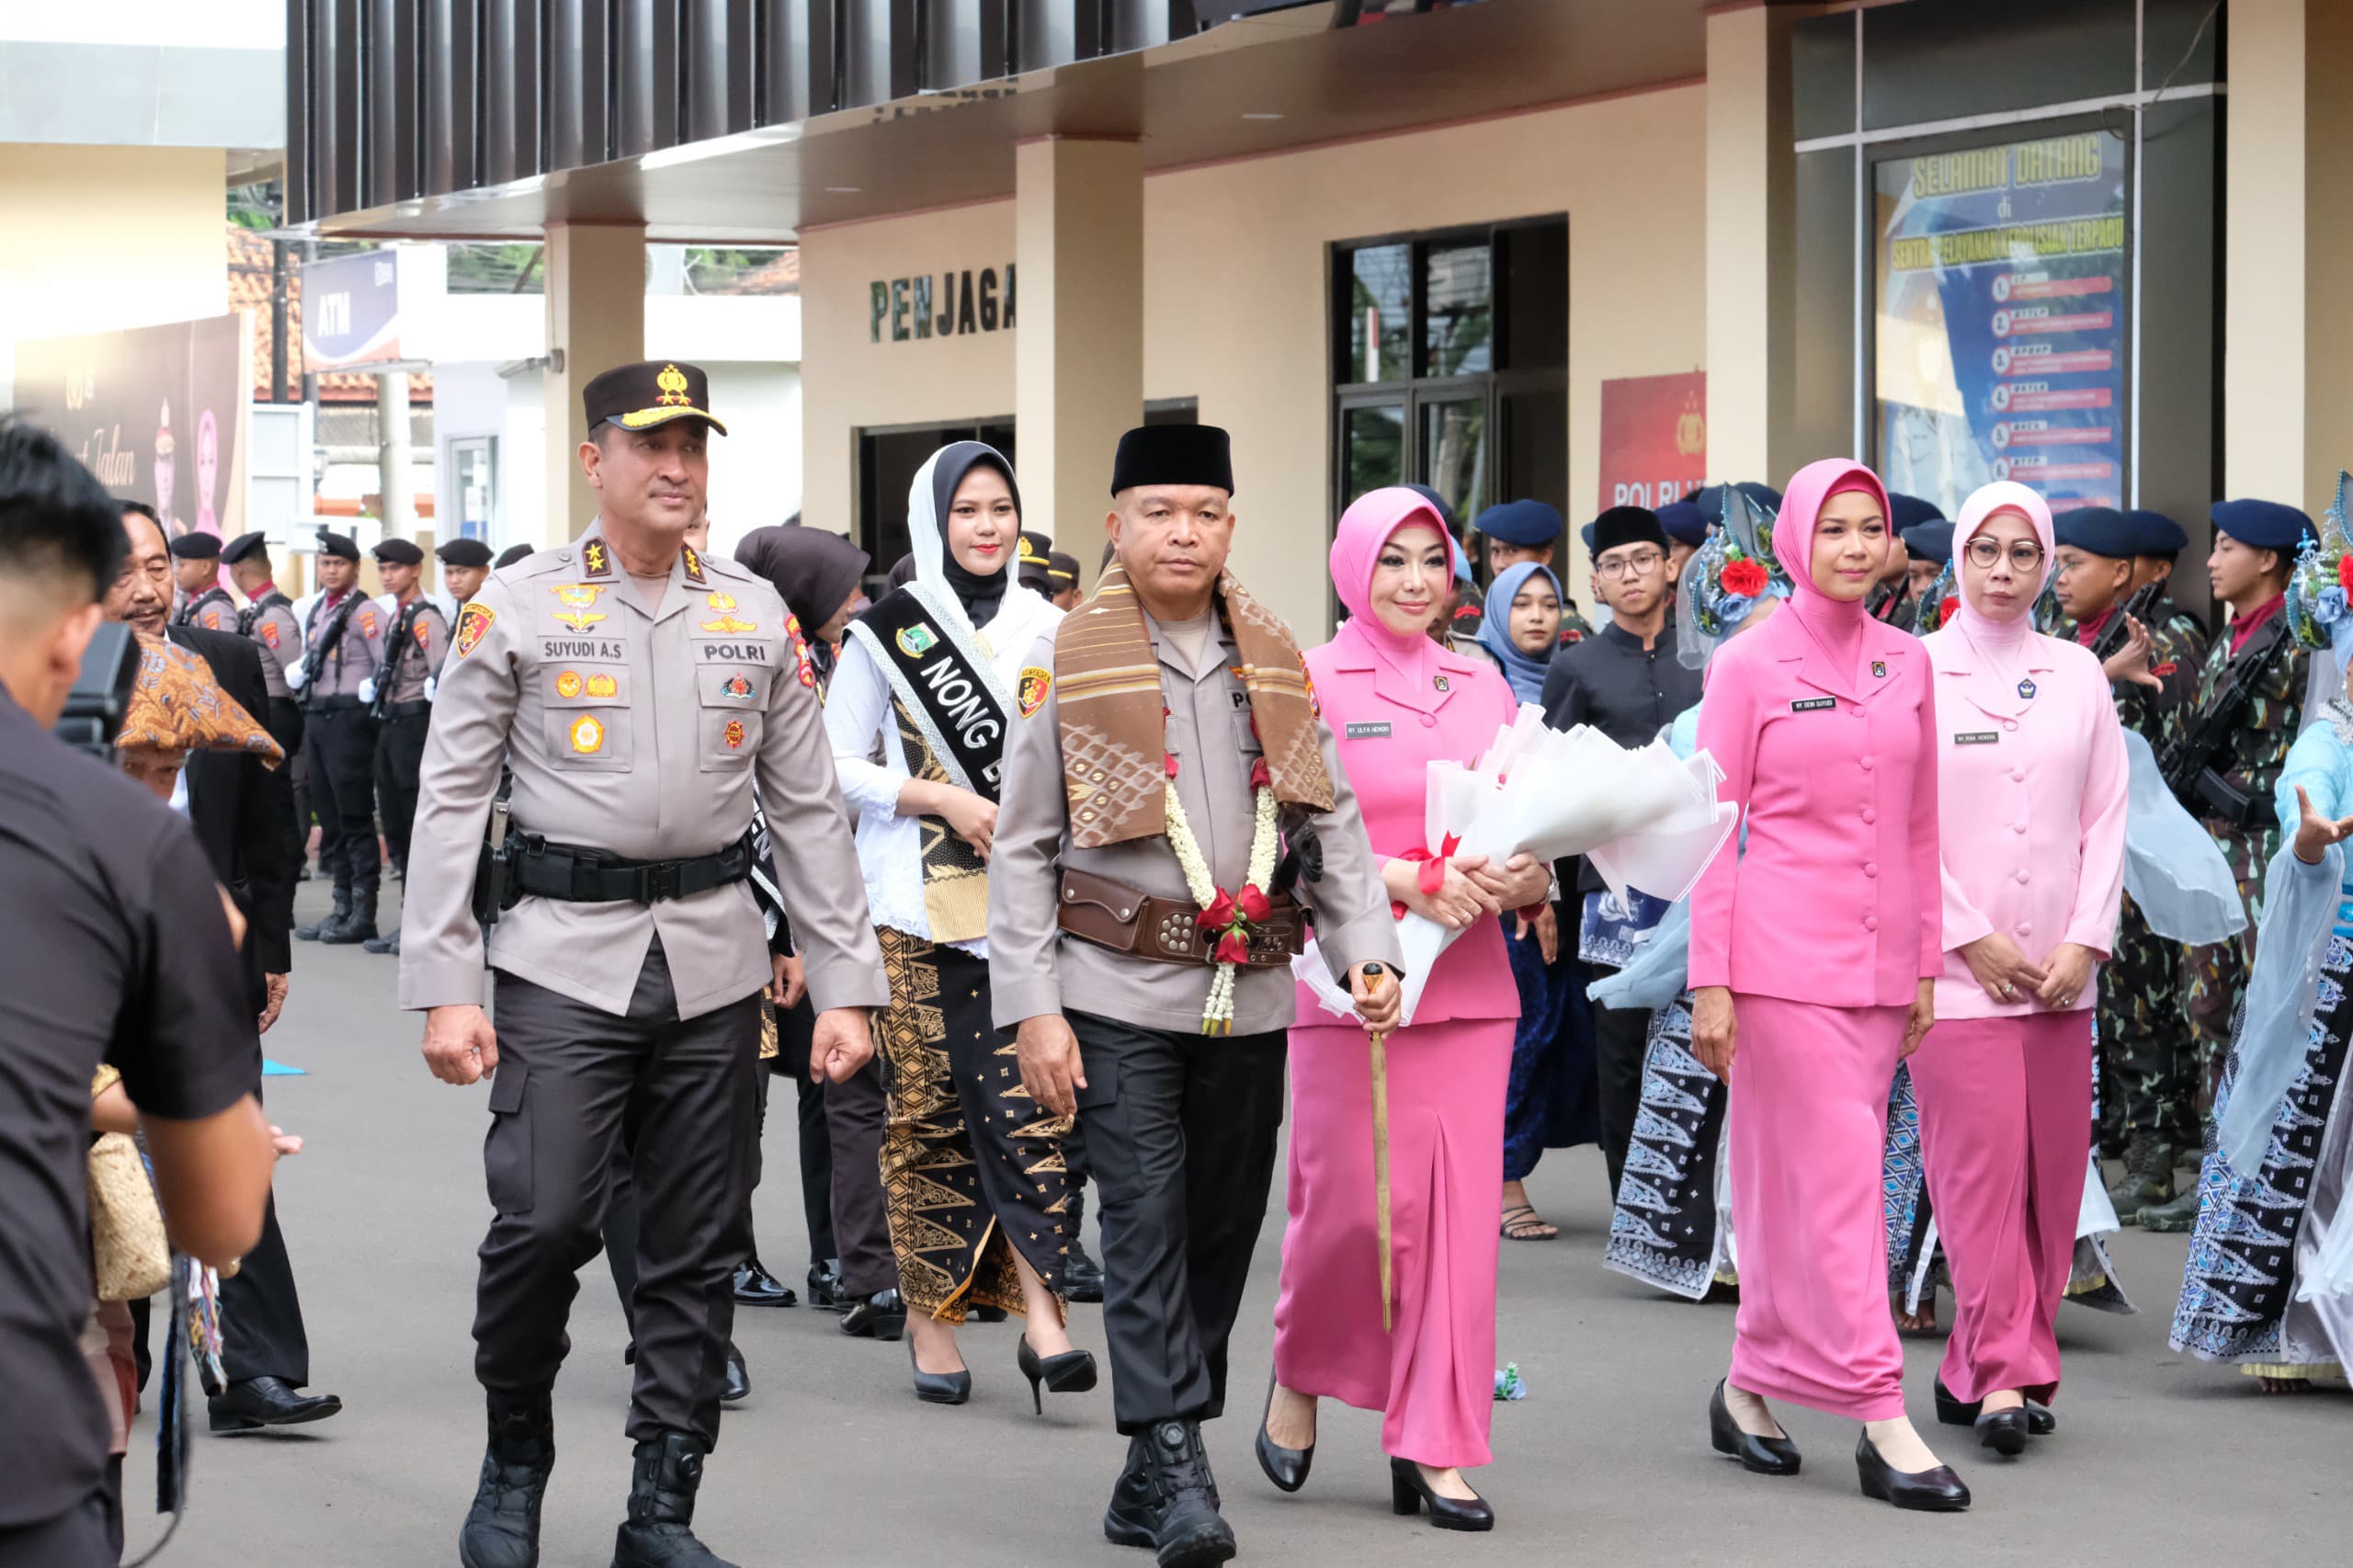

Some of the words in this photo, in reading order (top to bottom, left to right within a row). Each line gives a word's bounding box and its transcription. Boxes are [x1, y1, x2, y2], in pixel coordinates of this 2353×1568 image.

[1913, 146, 2009, 199] SELAMAT
[2014, 134, 2100, 185] DATANG
[1997, 196, 2011, 219] di
[2070, 216, 2124, 253] TERPADU
[317, 291, 351, 337] ATM
[870, 262, 1017, 344] PENJAGA
[545, 641, 596, 658] SUYUDI
[600, 642, 621, 660] A.S
[704, 644, 766, 661] POLRI
[920, 655, 1000, 750] NONG
